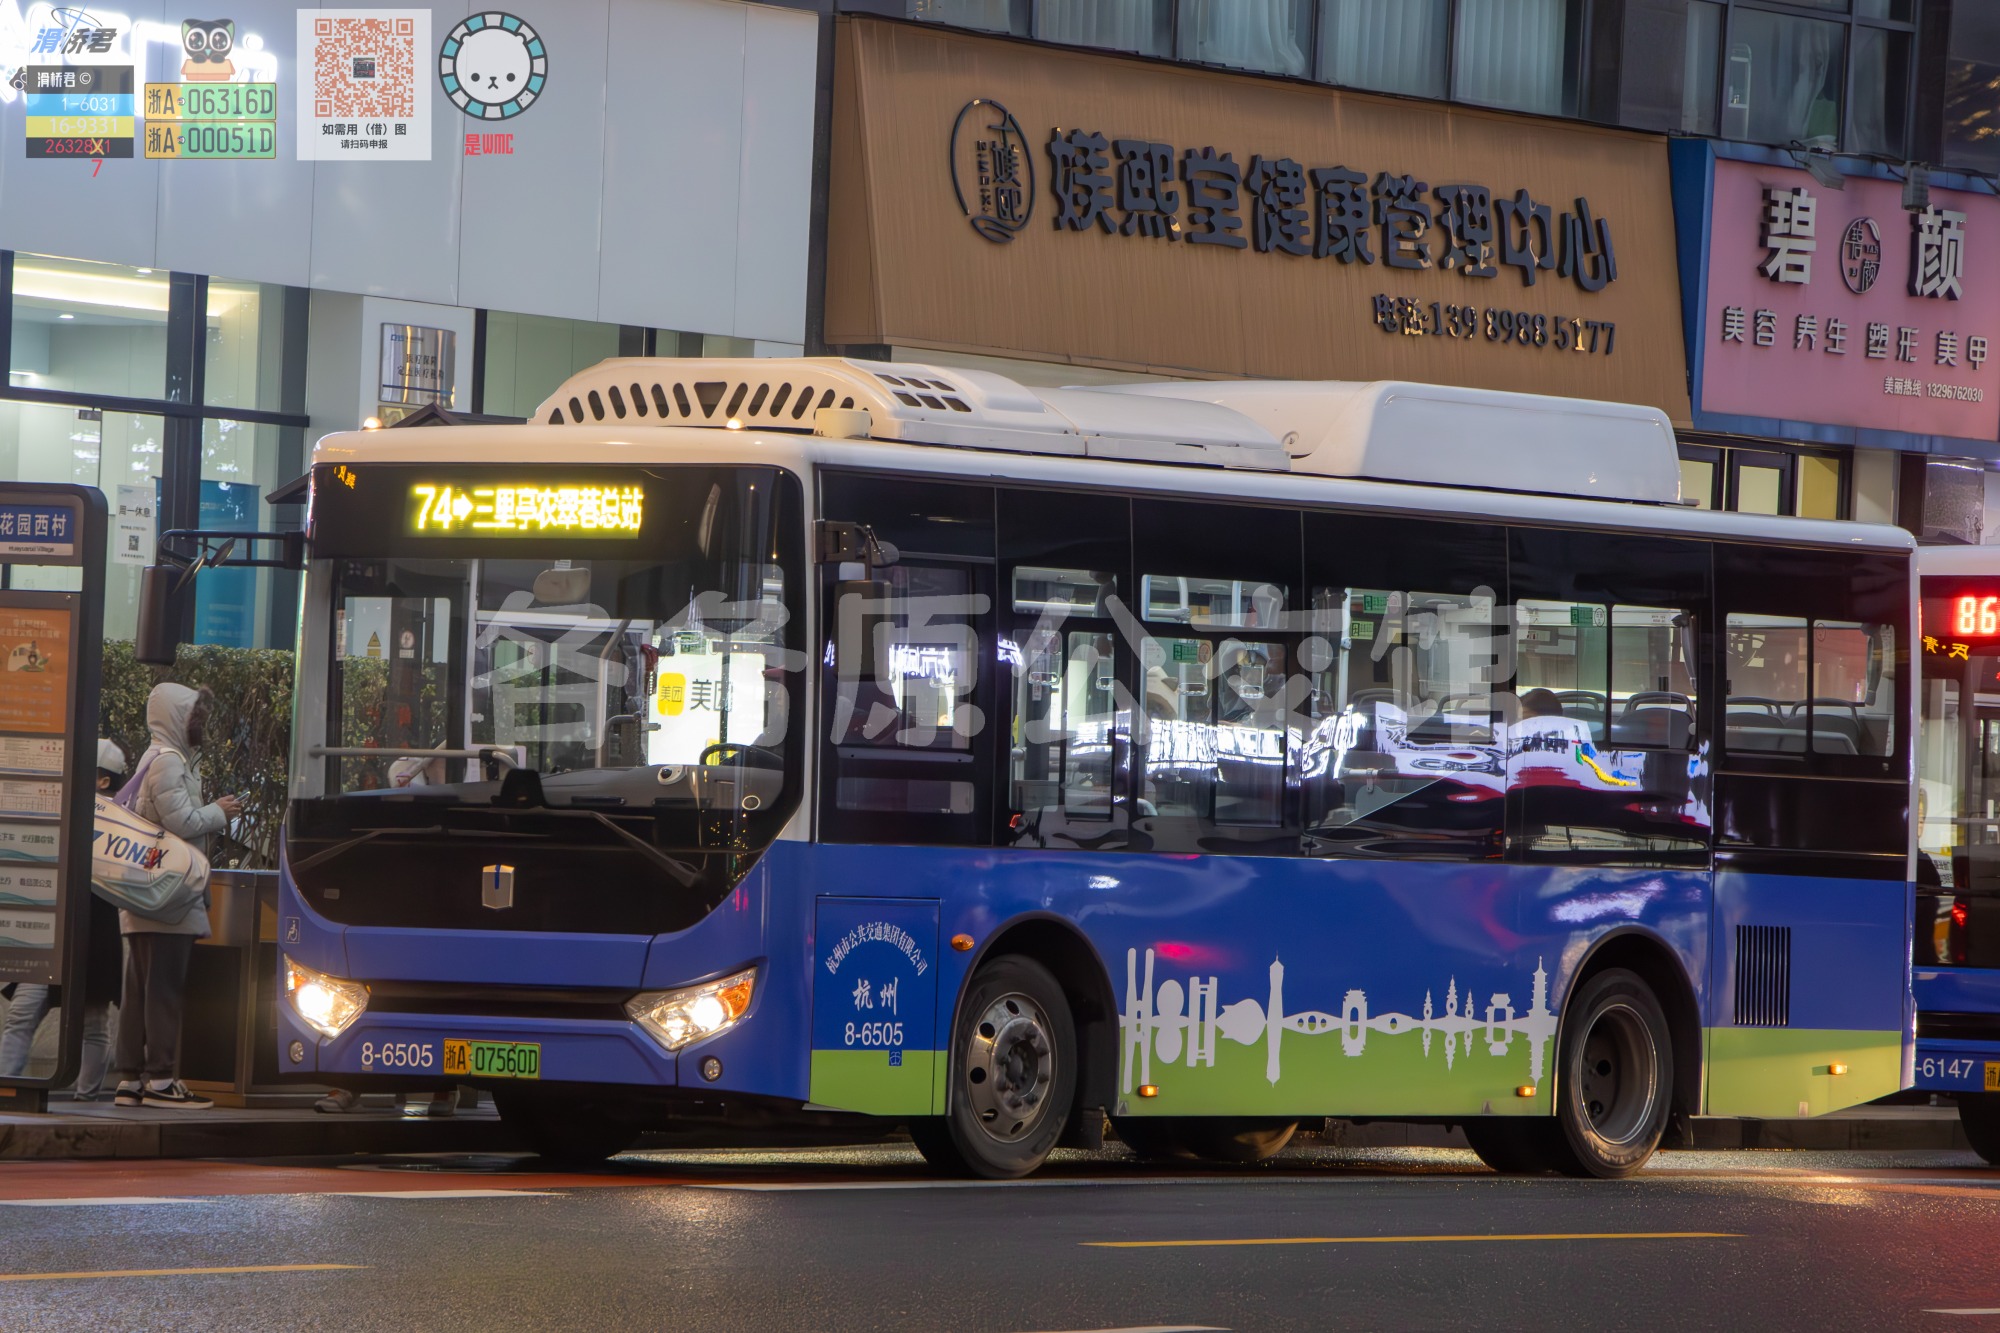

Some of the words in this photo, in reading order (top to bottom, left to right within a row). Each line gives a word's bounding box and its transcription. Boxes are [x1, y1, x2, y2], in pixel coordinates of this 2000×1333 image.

[1758, 187, 1816, 285] 碧
[1908, 204, 1967, 300] 颜
[1485, 307, 1549, 347] 8988
[1554, 315, 1616, 355] 5177
[1723, 306, 1777, 346] 美容
[1794, 315, 1848, 354] 养生
[1866, 323, 1919, 362] 塑形
[1936, 331, 1988, 370] 美甲
[1884, 376, 1921, 397] 美丽热线
[1926, 383, 1983, 402] 13296762030
[0, 513, 67, 537] 花园西村
[415, 486, 452, 530] 74
[660, 685, 683, 702] 美团
[825, 922, 928, 977] 杭州市公共交通集团有限公司
[852, 976, 899, 1017] 杭州
[844, 1021, 903, 1046] 8-6505
[361, 1042, 433, 1068] 8-6505
